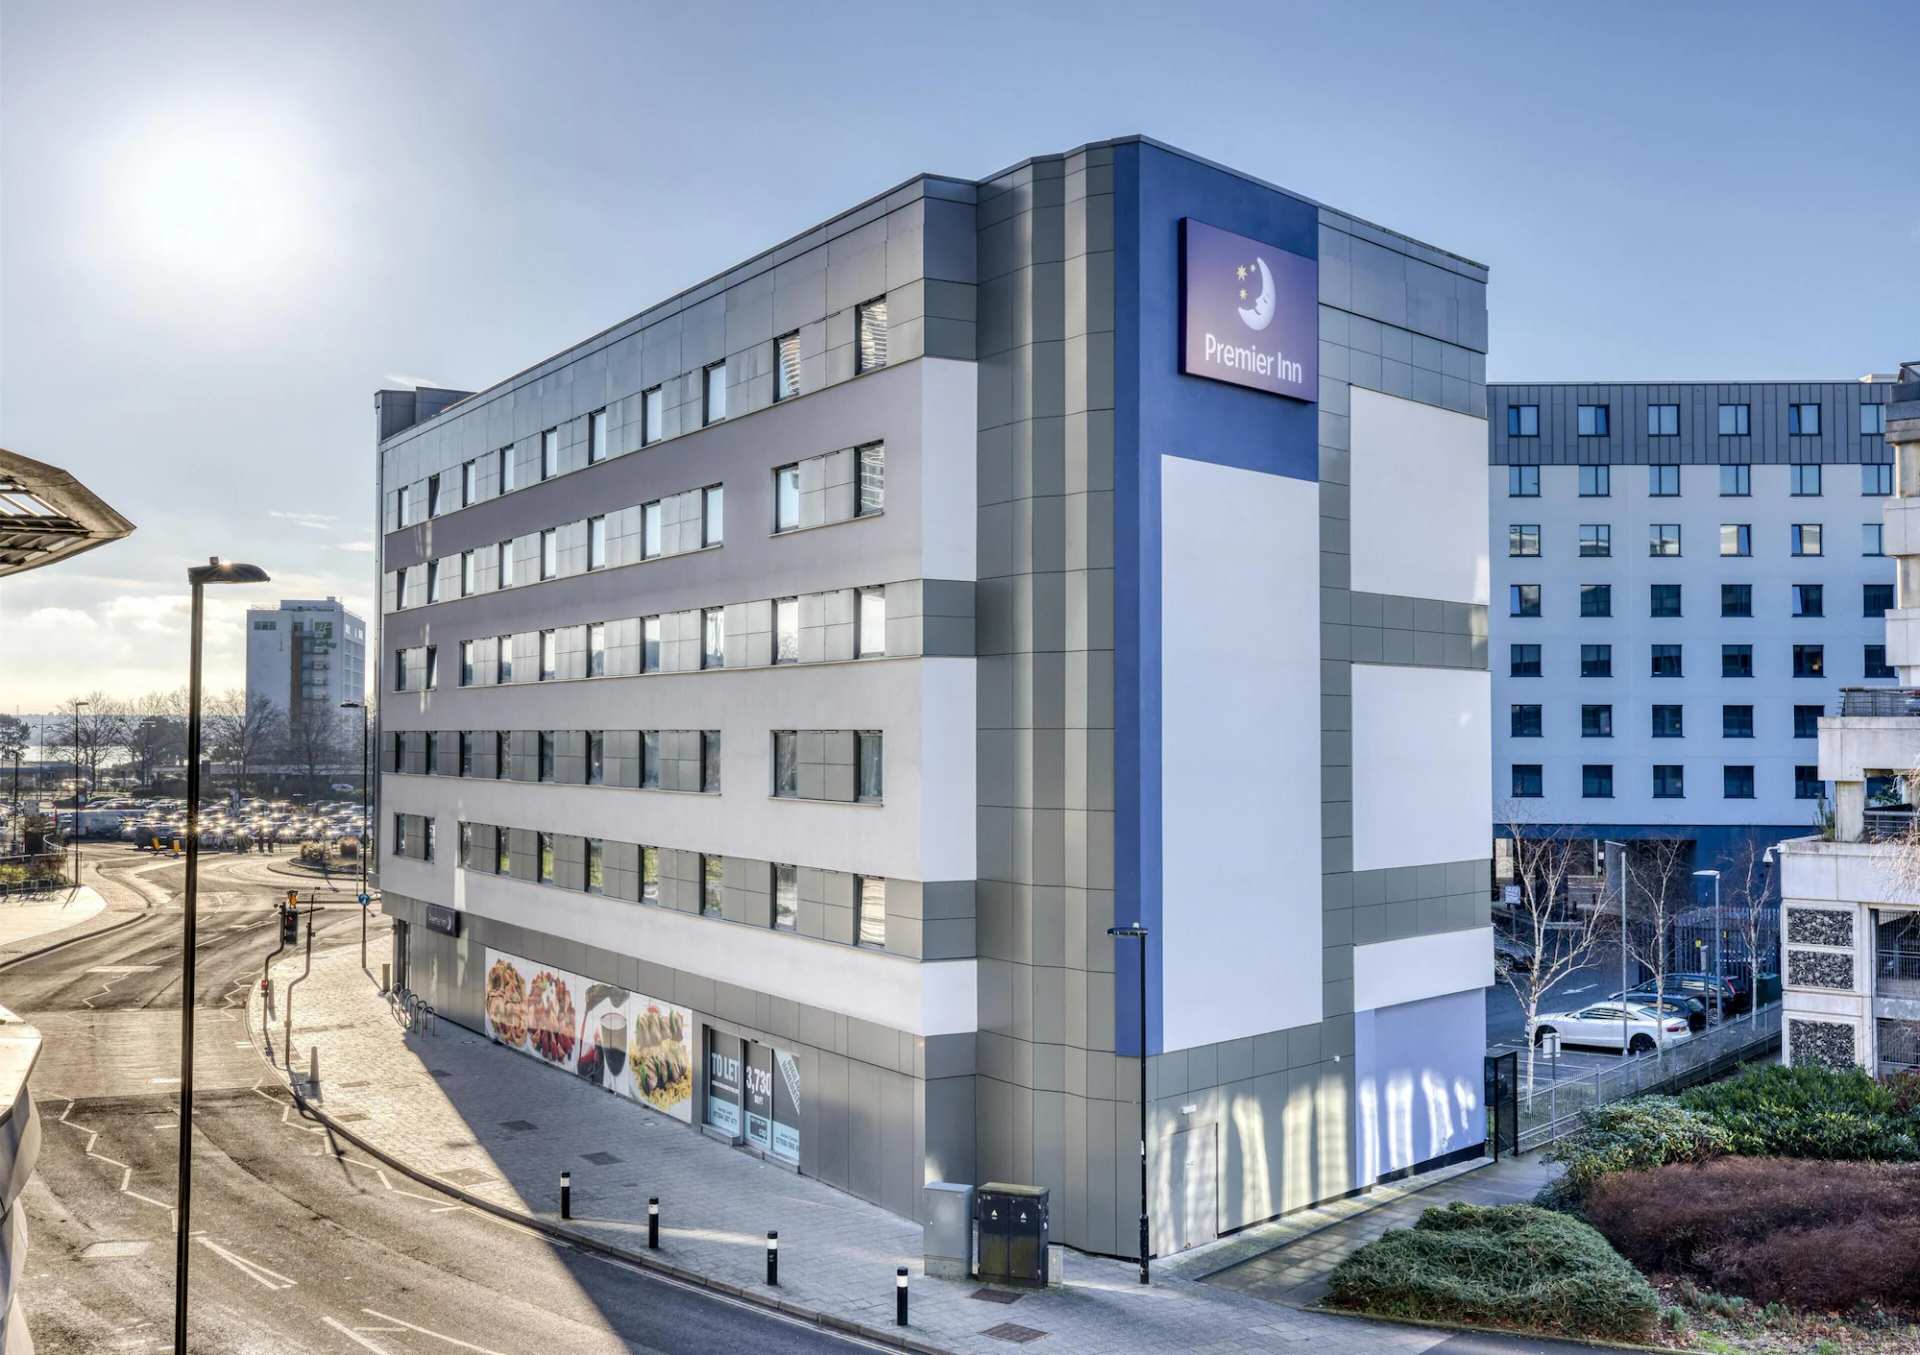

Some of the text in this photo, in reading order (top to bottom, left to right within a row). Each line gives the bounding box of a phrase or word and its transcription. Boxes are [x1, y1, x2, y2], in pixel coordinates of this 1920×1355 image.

[1205, 333, 1302, 383] Premier Inn
[712, 1053, 739, 1082] TO LET
[746, 1066, 771, 1096] 3,730
